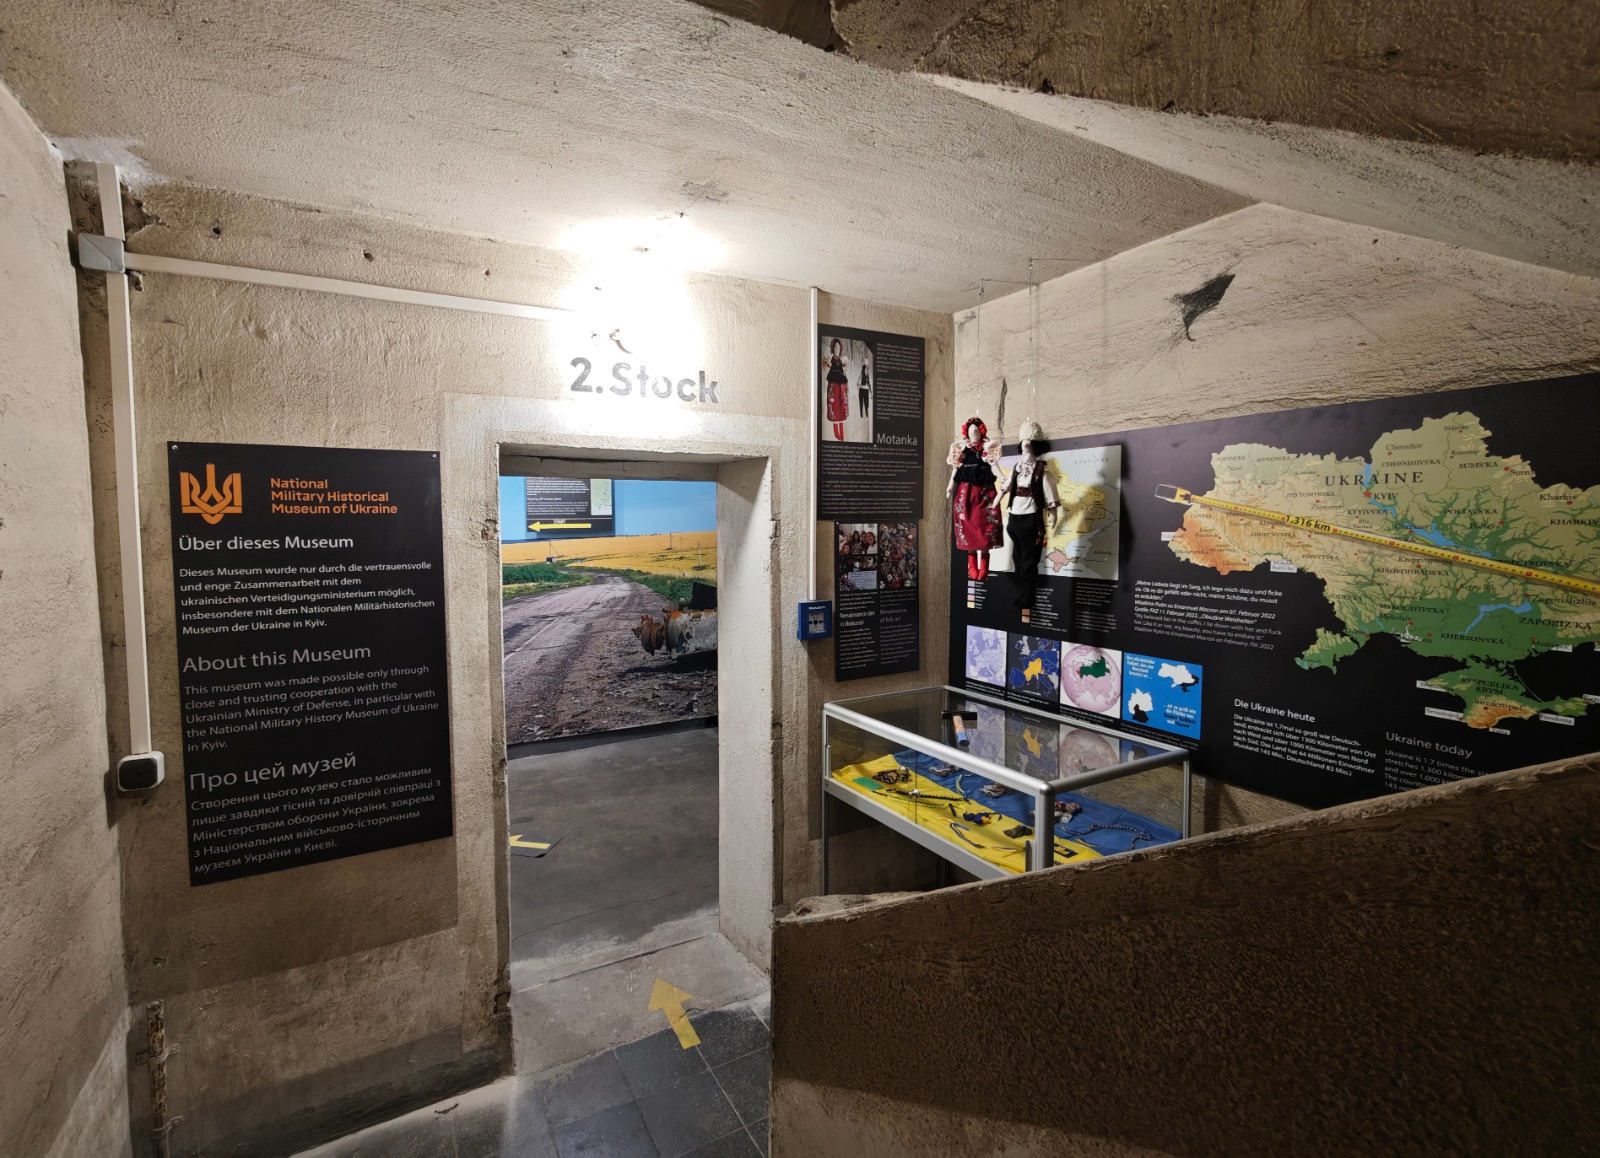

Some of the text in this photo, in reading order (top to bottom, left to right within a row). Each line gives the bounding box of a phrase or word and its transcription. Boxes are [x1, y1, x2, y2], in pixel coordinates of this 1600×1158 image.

[876, 433, 918, 445] Motanka
[271, 478, 328, 489] National
[1325, 471, 1424, 487] UKRAINE
[271, 490, 389, 503] Military Historical
[1374, 492, 1398, 500] KYIV
[272, 503, 398, 514] Museum of Ukraine
[1285, 514, 1331, 532] 1.316 km
[179, 536, 353, 550] Über dieses Museum
[179, 569, 214, 577] Dieses
[265, 566, 297, 574] wurde
[318, 564, 346, 573] durch
[364, 561, 432, 571] vertrauensvolle
[180, 583, 202, 591] und
[204, 584, 231, 592] enge
[234, 579, 320, 589] Zusammenarbeit
[340, 577, 361, 585] dem
[181, 588, 416, 606] ukrainischen Verteidigungsministerium möglich,
[182, 600, 435, 620] insbesondere mit dem Nationalen Militärhistorischen
[183, 626, 229, 634] Museum
[231, 623, 249, 631] der
[251, 621, 291, 630] Ukraine
[305, 619, 327, 628] Kyiv.
[183, 648, 371, 672] About this Museum
[184, 686, 208, 695] This
[211, 682, 261, 692] museum
[289, 675, 320, 685] made
[322, 671, 365, 684] possible
[367, 669, 388, 678] only
[390, 665, 429, 676] through
[185, 681, 397, 709] close and trusting cooperation with the
[186, 689, 435, 723] Ukrainian Ministry of Defense, in particular with
[1234, 699, 1315, 722] Die Ukraine heute
[186, 703, 439, 737] the National Military History Museum of Ukraine
[188, 740, 228, 752] in Kyiv.
[1386, 732, 1472, 759] Ukraine today
[1385, 749, 1414, 760] Ukraine
[1436, 761, 1459, 771] times
[1461, 766, 1475, 774] the
[1385, 758, 1418, 770] stretches
[190, 752, 356, 791] Про цей музей
[1384, 766, 1399, 774] and
[1400, 770, 1417, 778] over
[1384, 772, 1398, 782] The
[191, 768, 431, 810] Створення цього музею стало можливим
[192, 815, 226, 826] лише
[230, 806, 279, 820] завдяки
[282, 799, 316, 811] тісній
[332, 788, 381, 805] довірчій
[383, 779, 433, 795] співпраці
[193, 795, 435, 842] Міністерством оборони України, зокрема
[203, 834, 293, 855] Національним
[296, 811, 420, 839] військово-історичним
[195, 858, 241, 872] музеєм
[244, 849, 291, 863] України
[304, 841, 337, 852] Києві.
